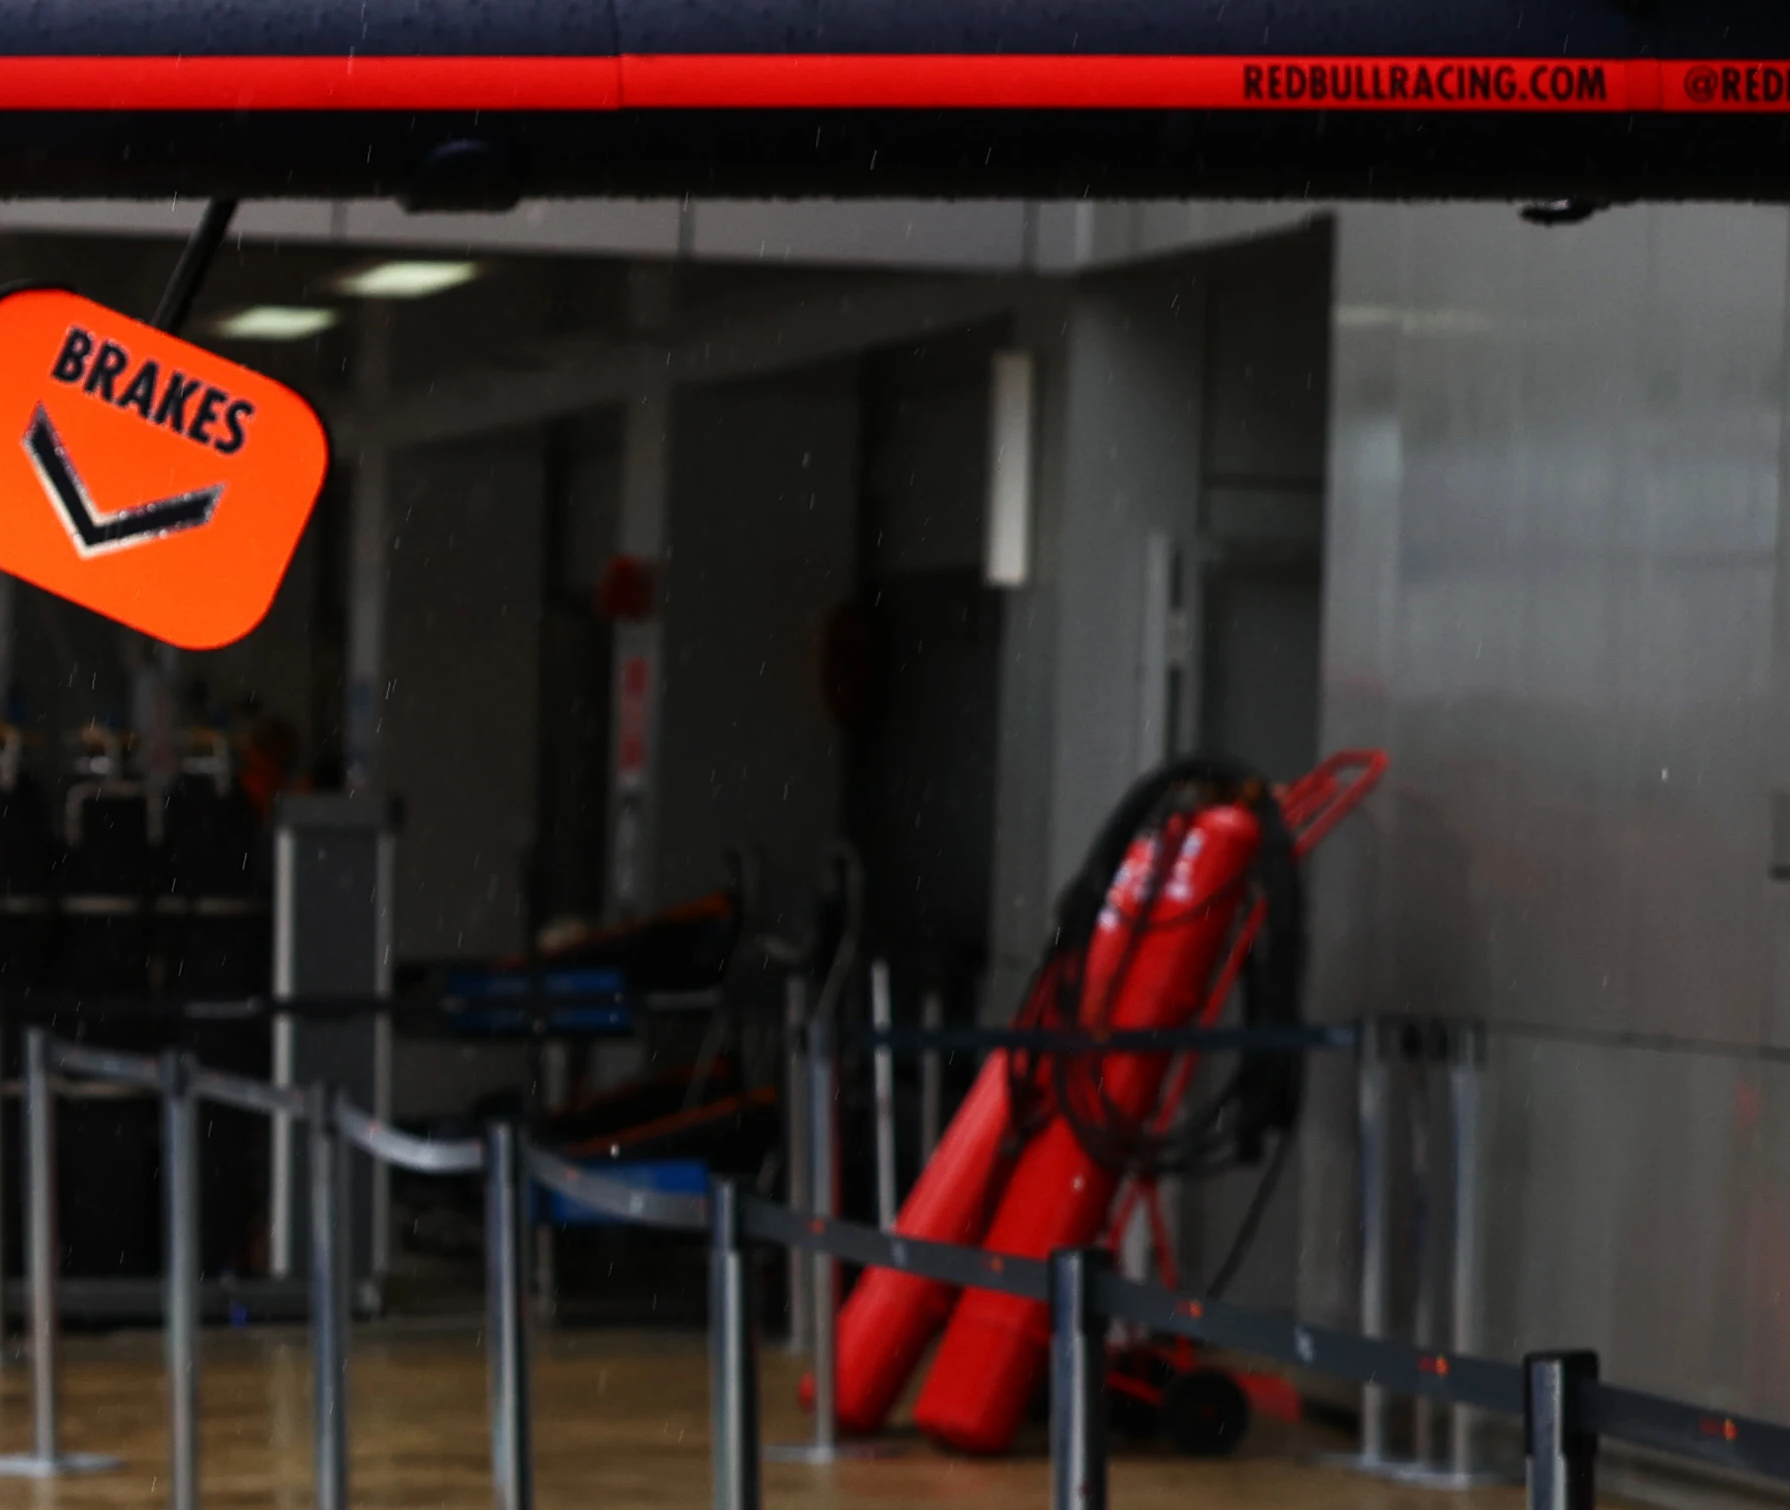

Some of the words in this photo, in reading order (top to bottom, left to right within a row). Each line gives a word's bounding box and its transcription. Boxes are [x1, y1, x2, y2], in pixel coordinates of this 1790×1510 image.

[1243, 65, 1607, 101] REDBULLRACING.COM
[1684, 64, 1790, 101] @RED
[51, 324, 256, 456] BRAKES
